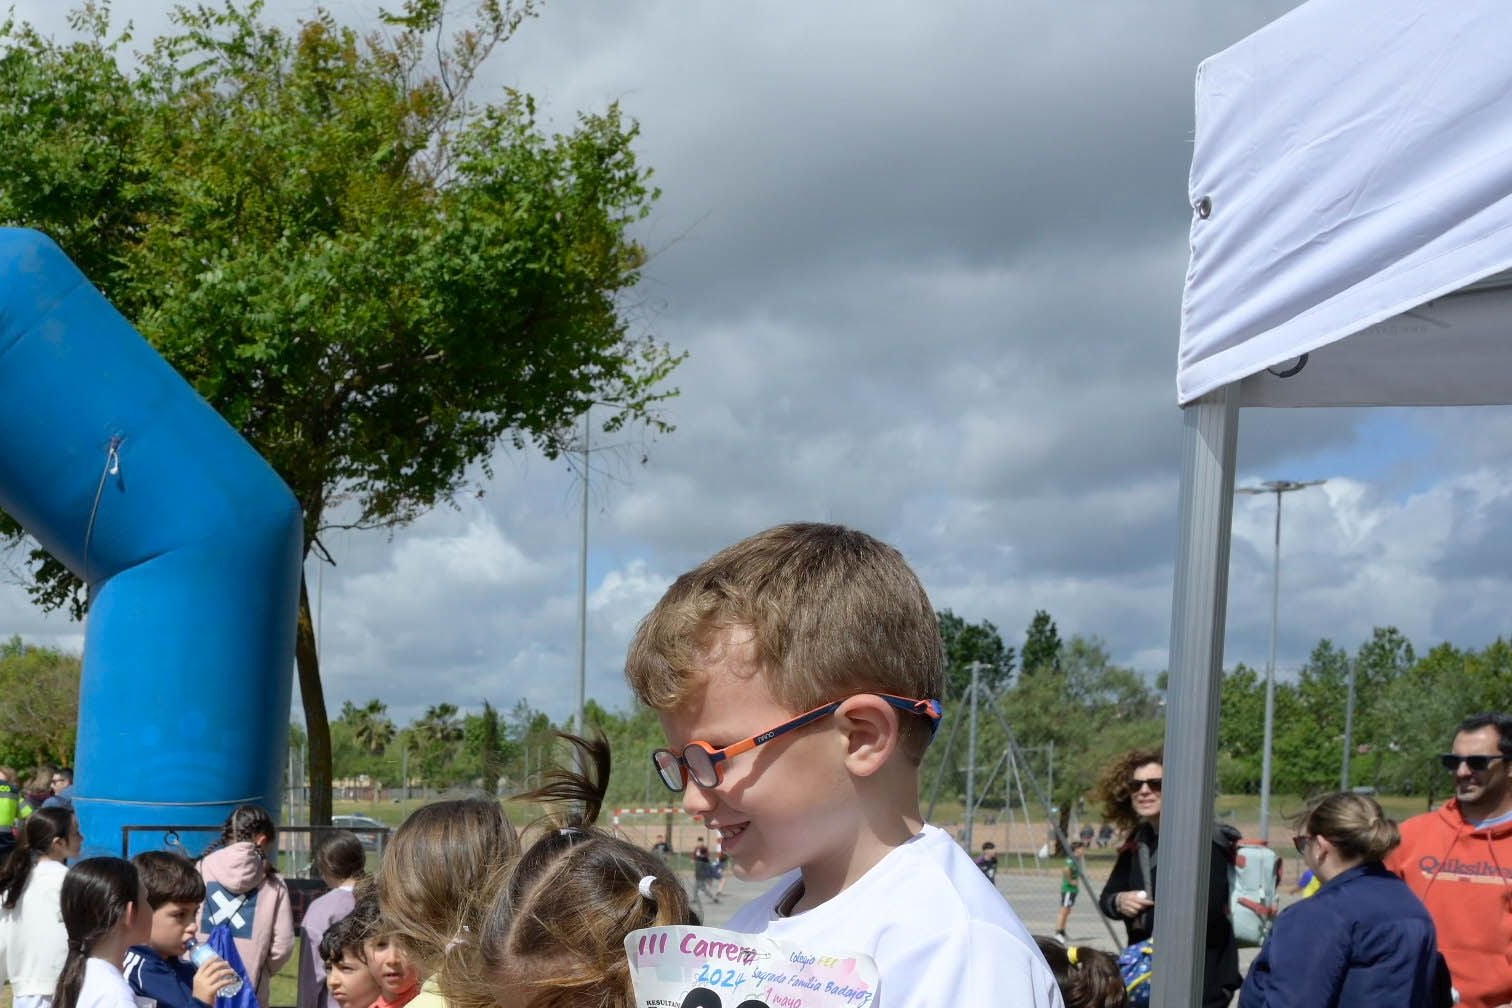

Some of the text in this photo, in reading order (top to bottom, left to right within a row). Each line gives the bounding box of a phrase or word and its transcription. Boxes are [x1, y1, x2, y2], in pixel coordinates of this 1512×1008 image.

[638, 932, 757, 966] III Carrera
[697, 963, 746, 993] 2024
[824, 981, 873, 1008] Badajoz
